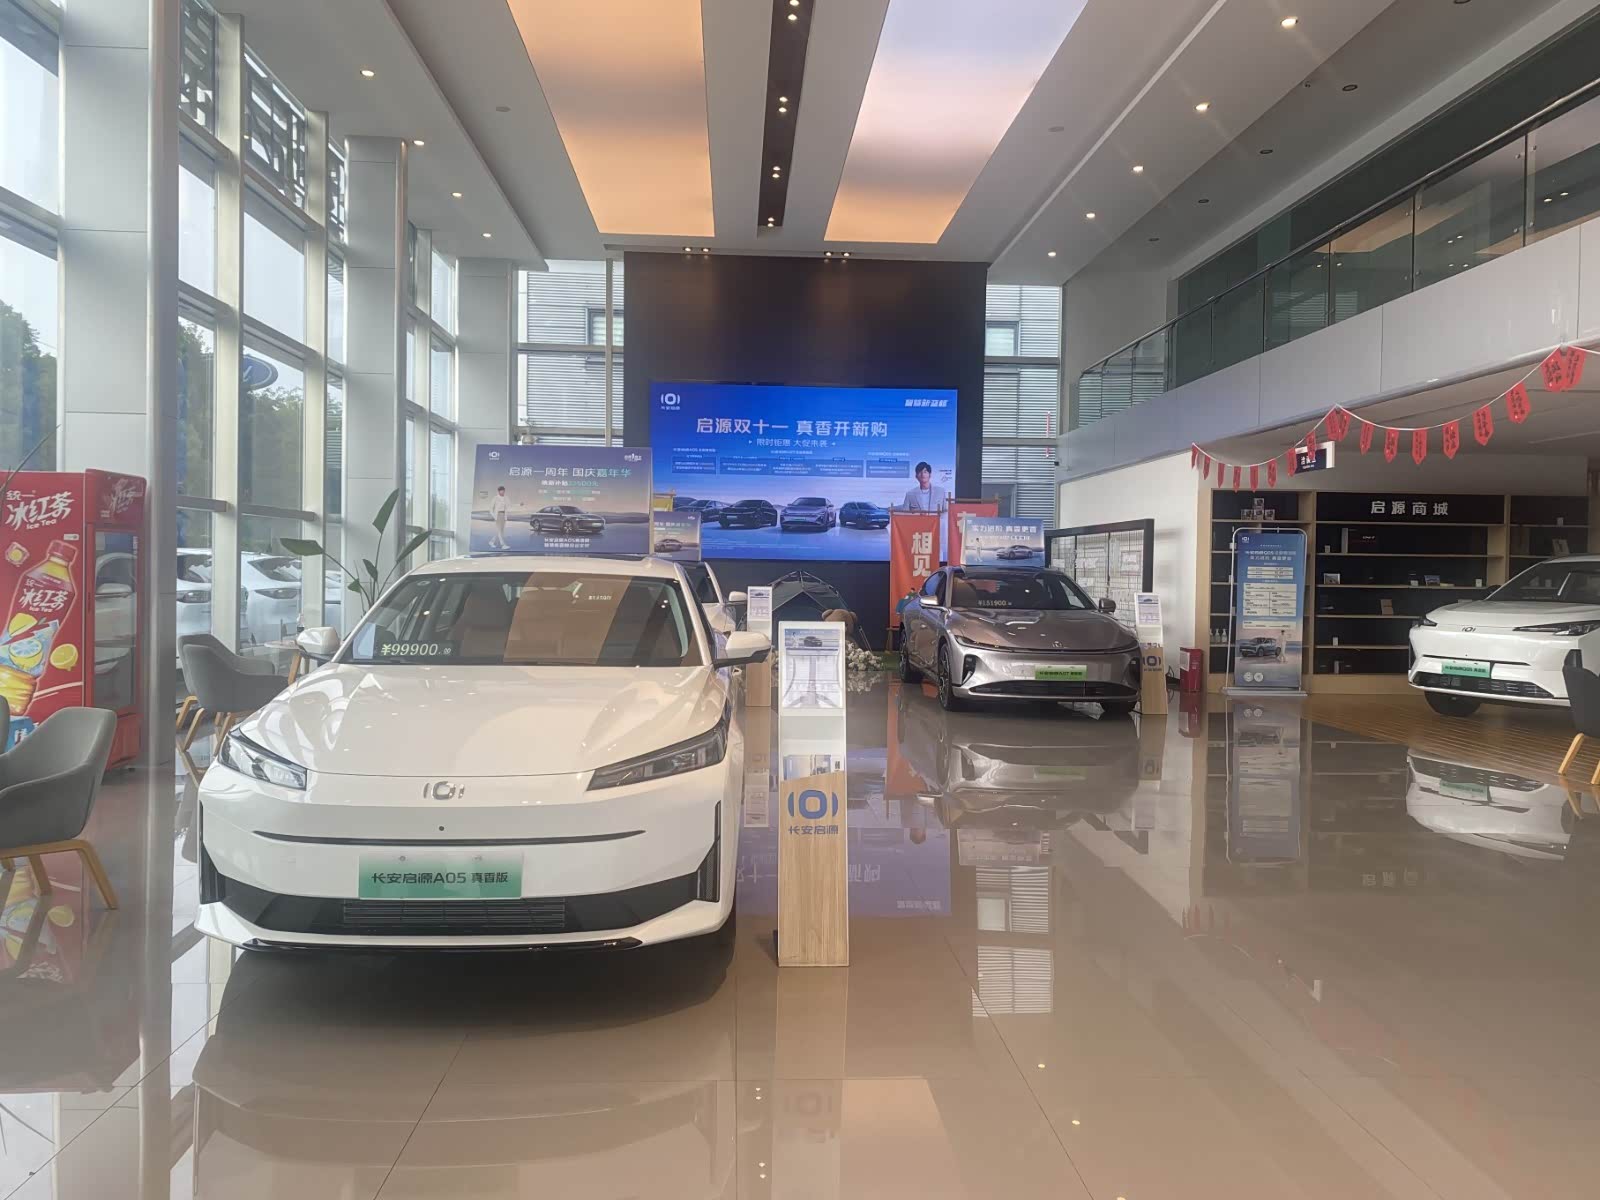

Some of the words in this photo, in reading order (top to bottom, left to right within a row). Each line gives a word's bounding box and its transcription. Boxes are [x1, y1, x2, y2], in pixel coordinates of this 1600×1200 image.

[697, 418, 789, 435] 启源双十一
[796, 420, 888, 437] 真香开新购
[509, 466, 569, 477] 启源一周年
[572, 467, 632, 478] 国庆嘉年华
[6, 490, 35, 501] 统一
[5, 491, 75, 530] 冰红茶
[1370, 501, 1449, 516] 启源商城
[911, 532, 933, 577] 相见
[19, 588, 69, 611] 冰红茶
[788, 825, 839, 835] 长安启源
[371, 872, 467, 884] 长安启源A05
[471, 872, 508, 883] 真香版
